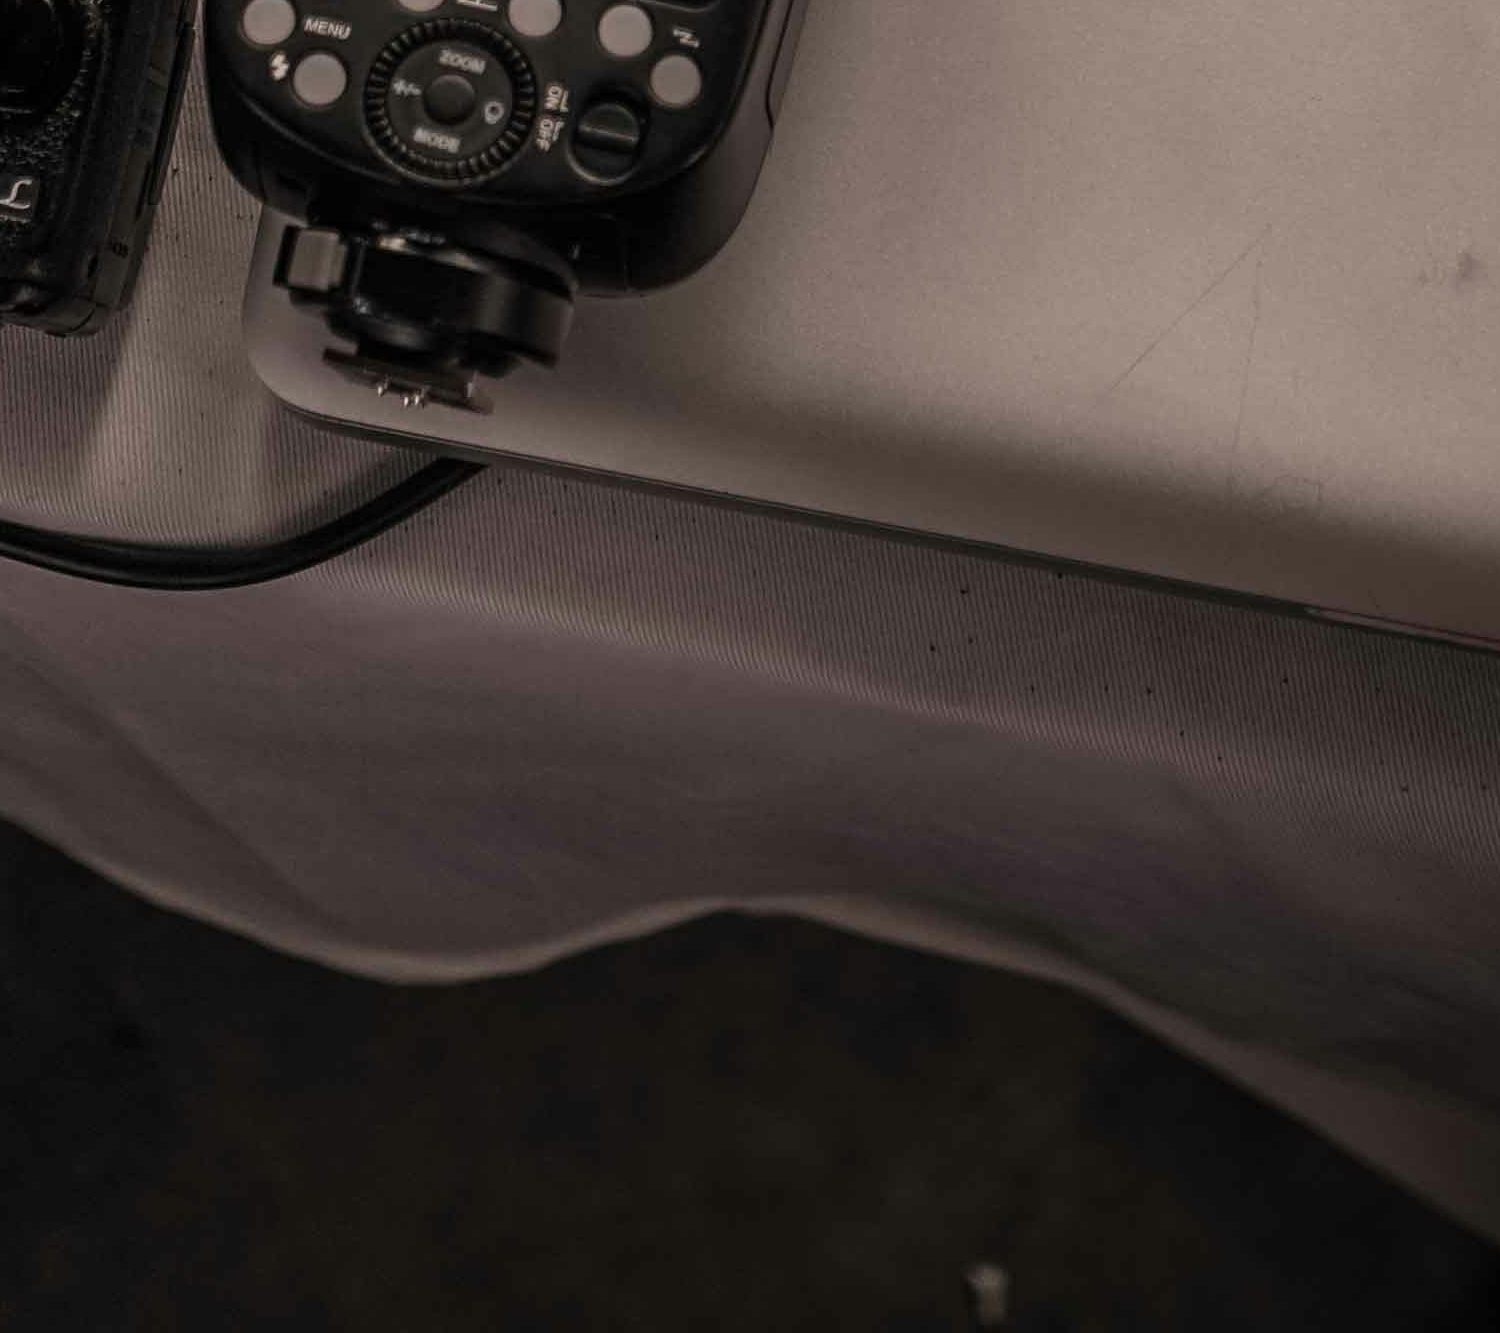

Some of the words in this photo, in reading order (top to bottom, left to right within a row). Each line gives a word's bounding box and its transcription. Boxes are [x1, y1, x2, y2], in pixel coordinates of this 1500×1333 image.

[304, 18, 352, 40] MENU
[439, 49, 486, 74] ZOOM
[545, 86, 560, 110] ON
[413, 127, 461, 153] MODE
[537, 118, 554, 152] OFF
